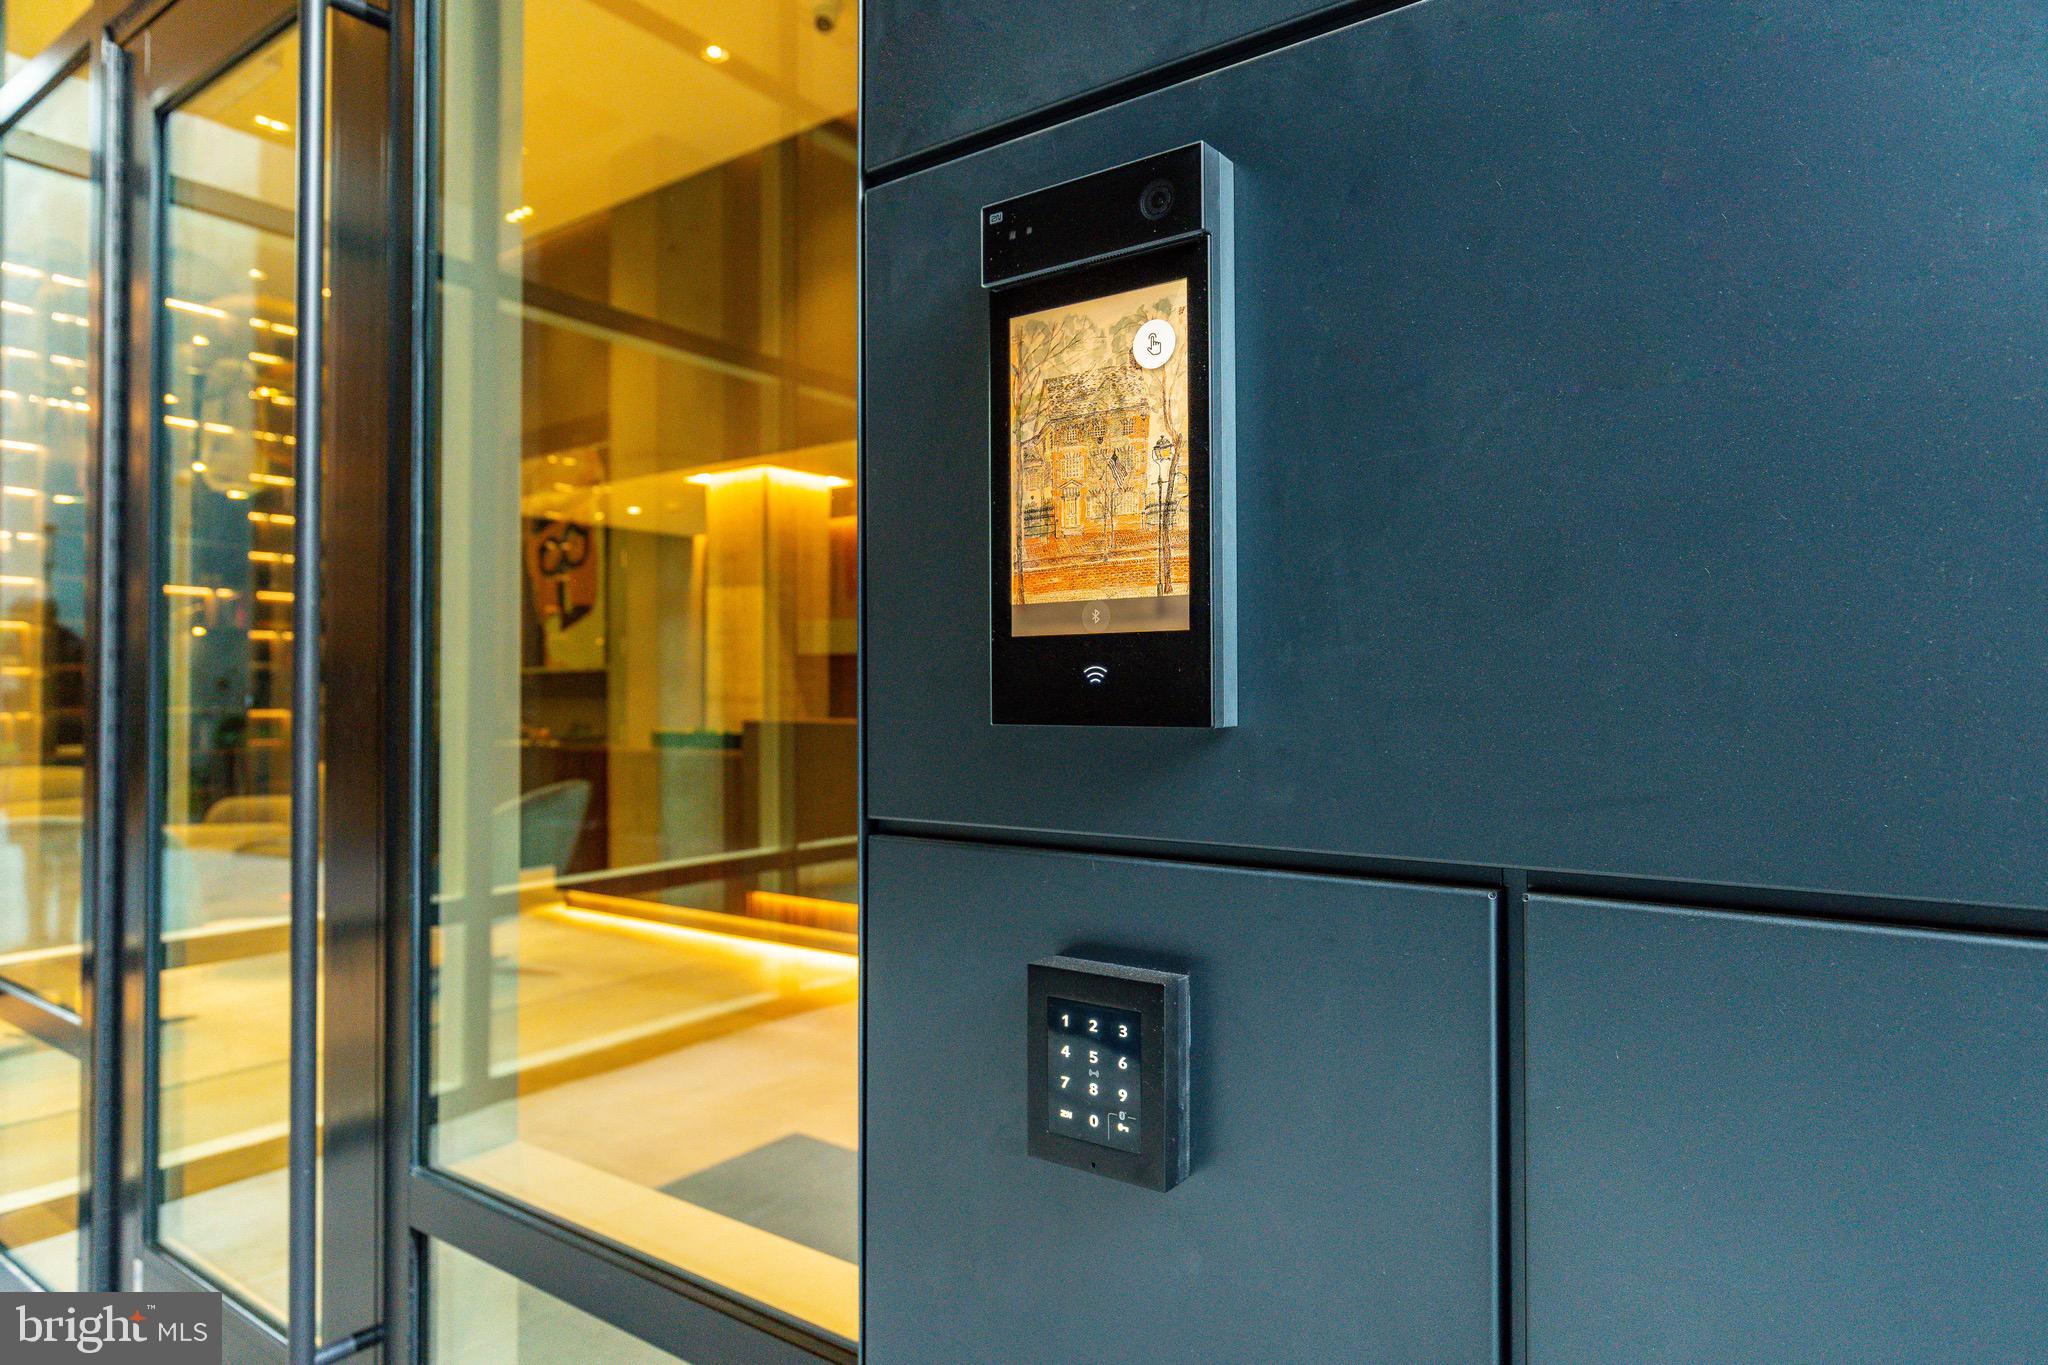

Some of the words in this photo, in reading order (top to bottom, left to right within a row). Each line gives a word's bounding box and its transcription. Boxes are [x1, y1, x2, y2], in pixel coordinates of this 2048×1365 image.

[1061, 1014, 1070, 1027] 1
[1088, 1019, 1099, 1033] 2
[1118, 1024, 1128, 1038] 3
[1060, 1045, 1071, 1058] 4
[1088, 1051, 1099, 1064] 5
[1117, 1057, 1128, 1070] 6
[1060, 1075, 1071, 1089] 7
[1088, 1083, 1099, 1096] 8
[1117, 1089, 1128, 1102] 9
[1088, 1114, 1100, 1128] 0
